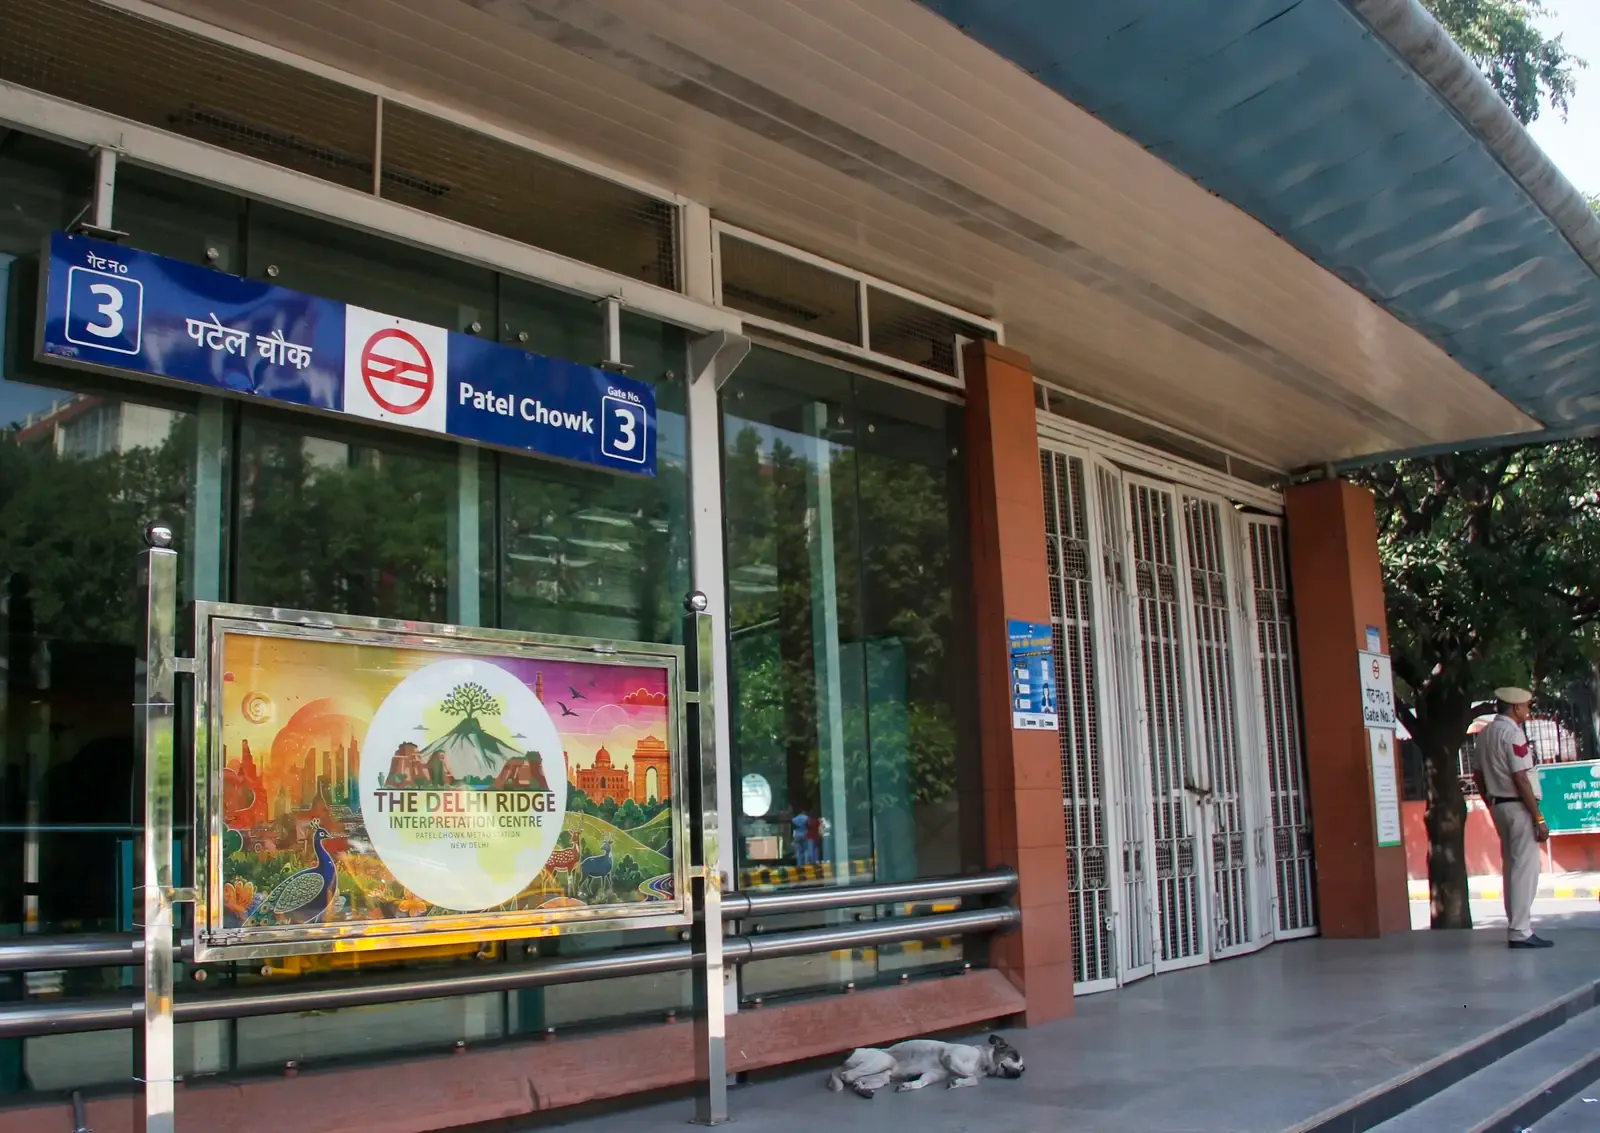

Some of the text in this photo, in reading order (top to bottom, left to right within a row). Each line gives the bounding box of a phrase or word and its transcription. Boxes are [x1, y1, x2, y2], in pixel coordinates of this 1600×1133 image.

[86, 251, 106, 269] गेट
[86, 283, 123, 338] 3
[186, 312, 312, 369] पटेल चौक
[607, 386, 641, 403] Gate No.
[459, 381, 594, 434] Patel Chowk
[613, 408, 636, 451] 3
[1364, 706, 1396, 724] Gate No. 3
[374, 791, 556, 813] THE DELHI RIDGE
[1583, 790, 1600, 799] MAR
[389, 815, 543, 829] INTERPRETATION CENTRE
[415, 830, 520, 839] PATEL CHOWK METRO STATION
[469, 841, 489, 849] DELHI
